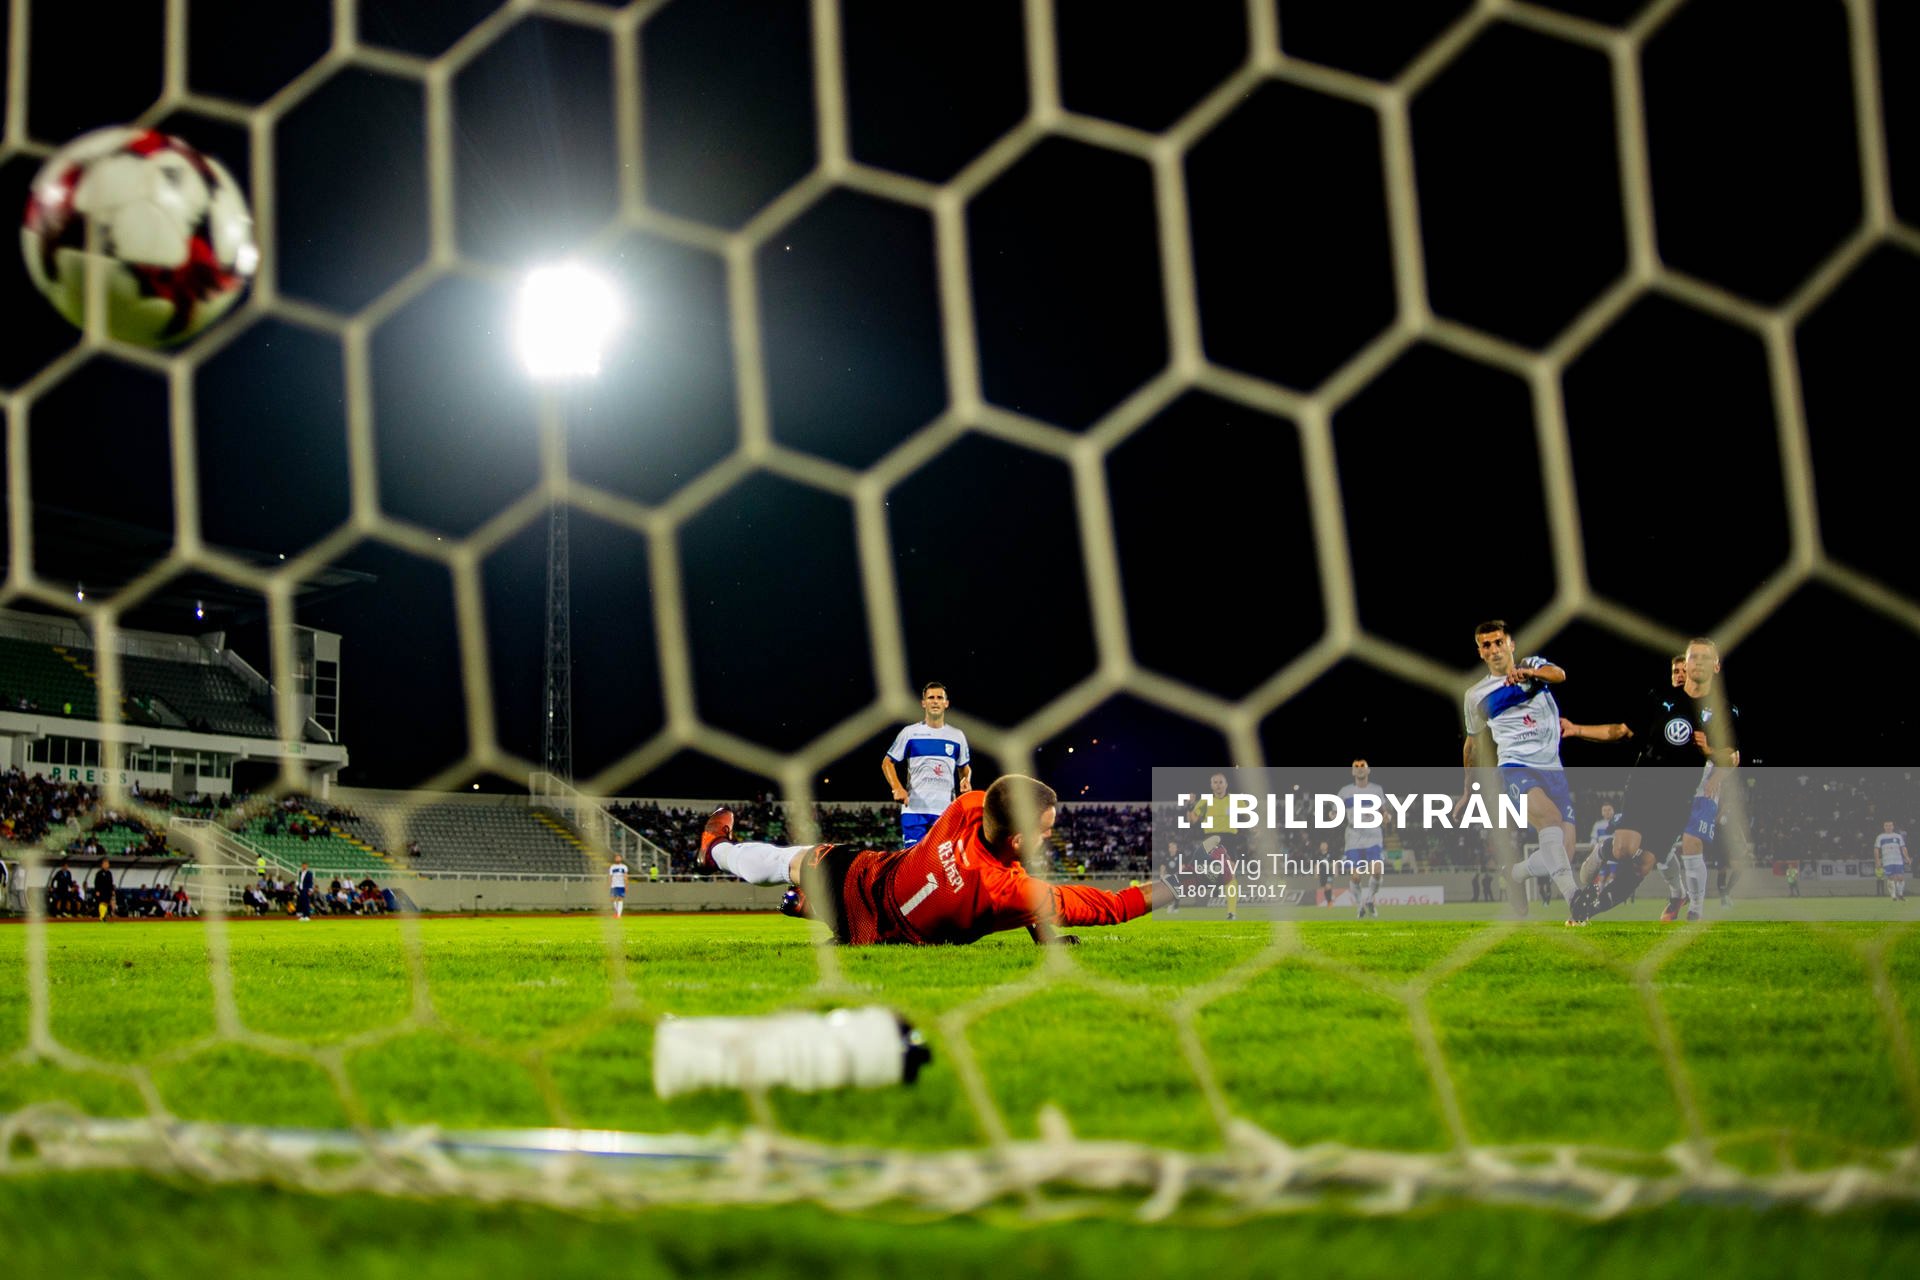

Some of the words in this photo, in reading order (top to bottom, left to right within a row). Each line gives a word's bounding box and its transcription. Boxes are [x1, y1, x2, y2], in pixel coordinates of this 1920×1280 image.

[52, 767, 127, 784] PRESS
[938, 840, 964, 893] REXHEPI
[900, 872, 938, 916] 1
